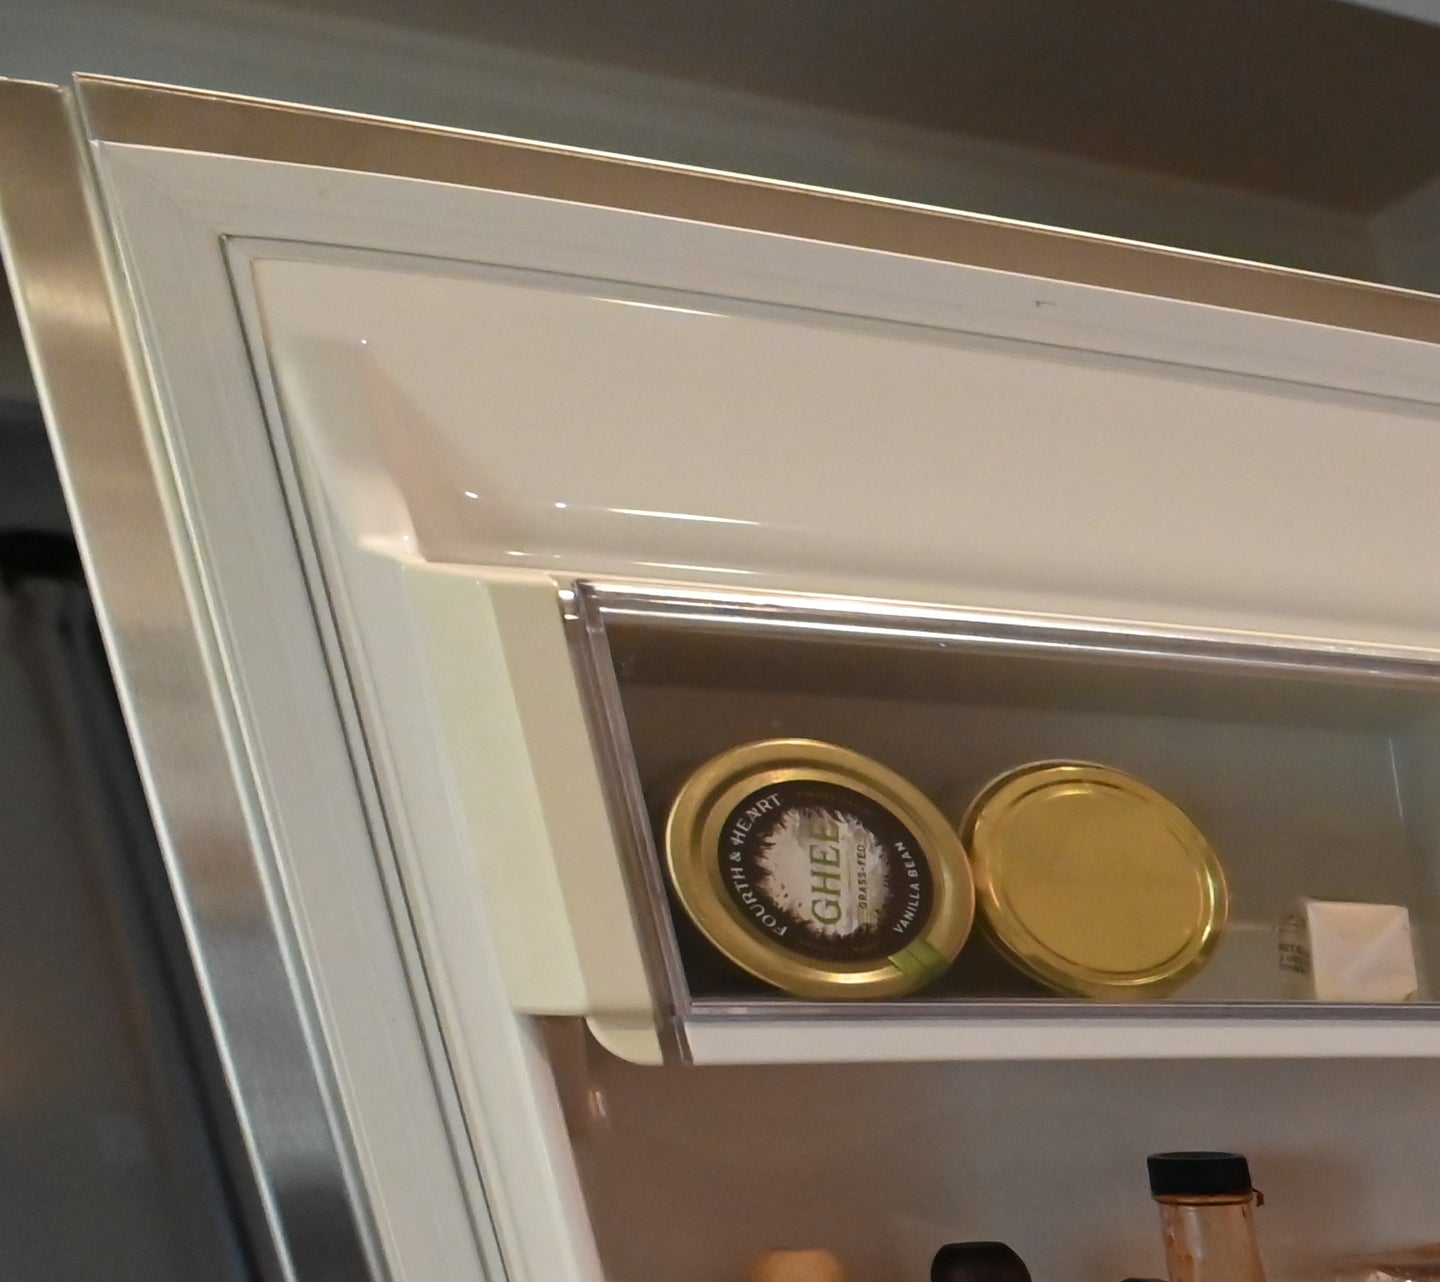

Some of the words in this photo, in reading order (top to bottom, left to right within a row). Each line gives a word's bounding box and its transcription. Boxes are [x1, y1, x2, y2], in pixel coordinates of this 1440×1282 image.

[731, 793, 781, 846] HEART
[729, 852, 741, 862] &
[809, 822, 841, 925] GHEE
[857, 844, 867, 909] GRASS-FED
[894, 841, 919, 878] BEAN
[731, 866, 787, 936] FOURTH
[893, 883, 920, 933] VANILLA
